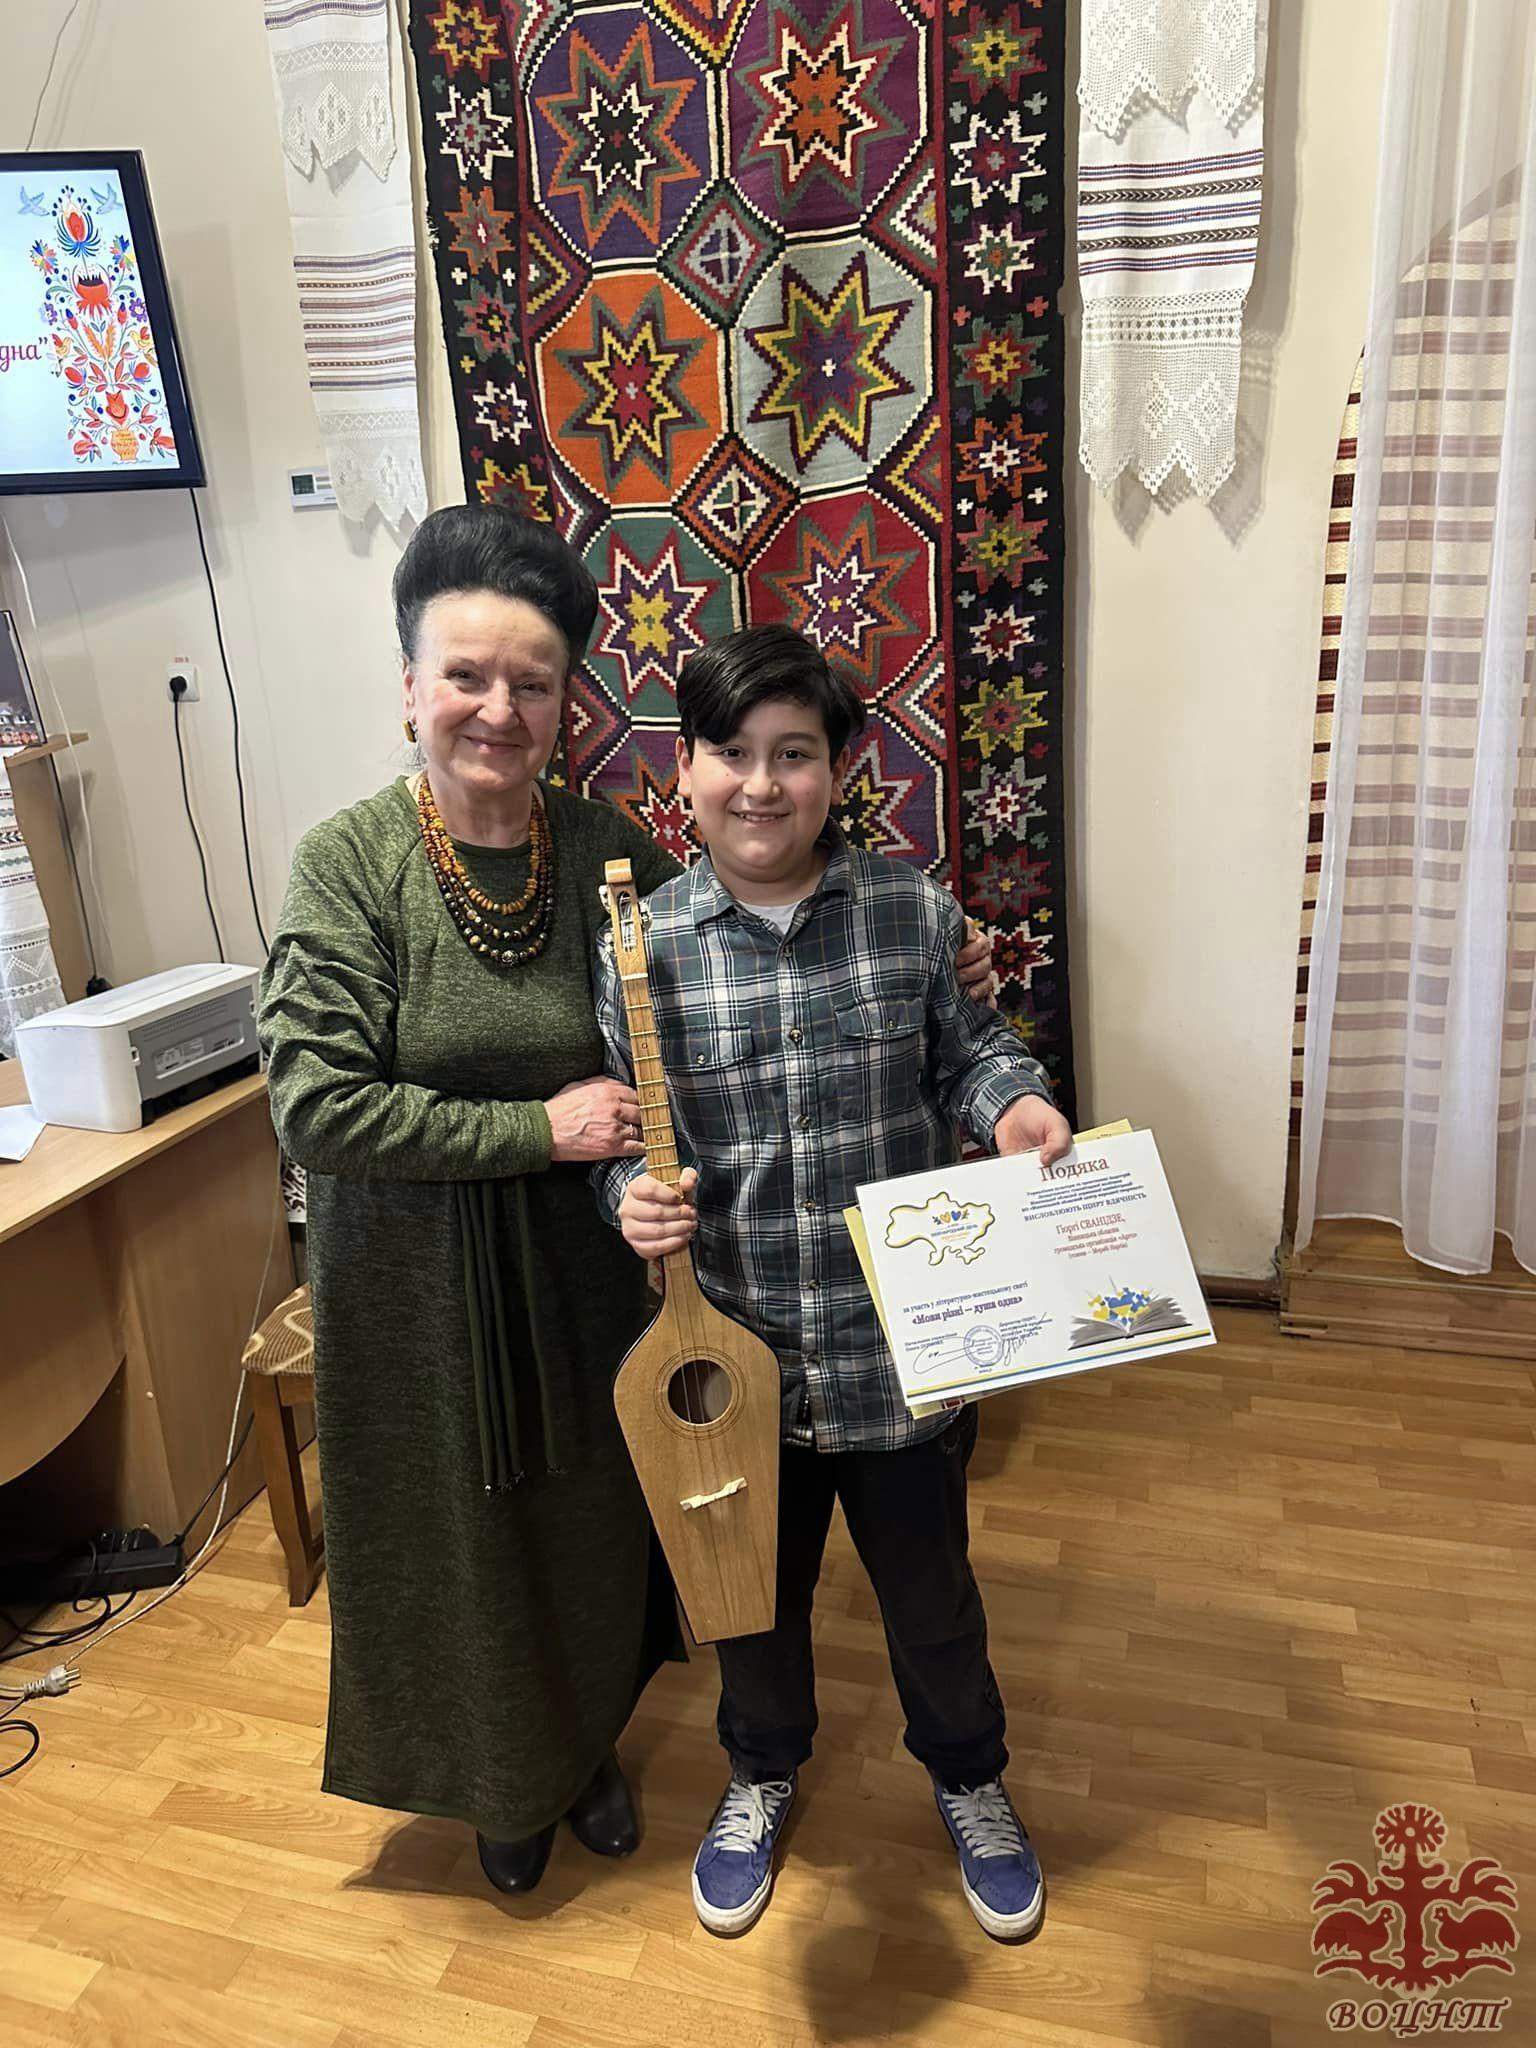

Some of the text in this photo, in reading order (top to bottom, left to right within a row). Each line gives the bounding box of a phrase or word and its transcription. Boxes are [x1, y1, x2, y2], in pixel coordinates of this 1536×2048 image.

[1040, 1158, 1110, 1182] Подяка
[1024, 1205, 1082, 1221] ВИСЛОВЛЮЮТЬ
[1082, 1200, 1105, 1212] ЩИРУ
[1106, 1192, 1147, 1206] ВДЯЧНІСТЬ
[910, 1303, 931, 1313] участь
[912, 1312, 942, 1325] «Мови
[942, 1306, 964, 1321] різні
[974, 1301, 997, 1314] душа
[997, 1296, 1023, 1308] одна»
